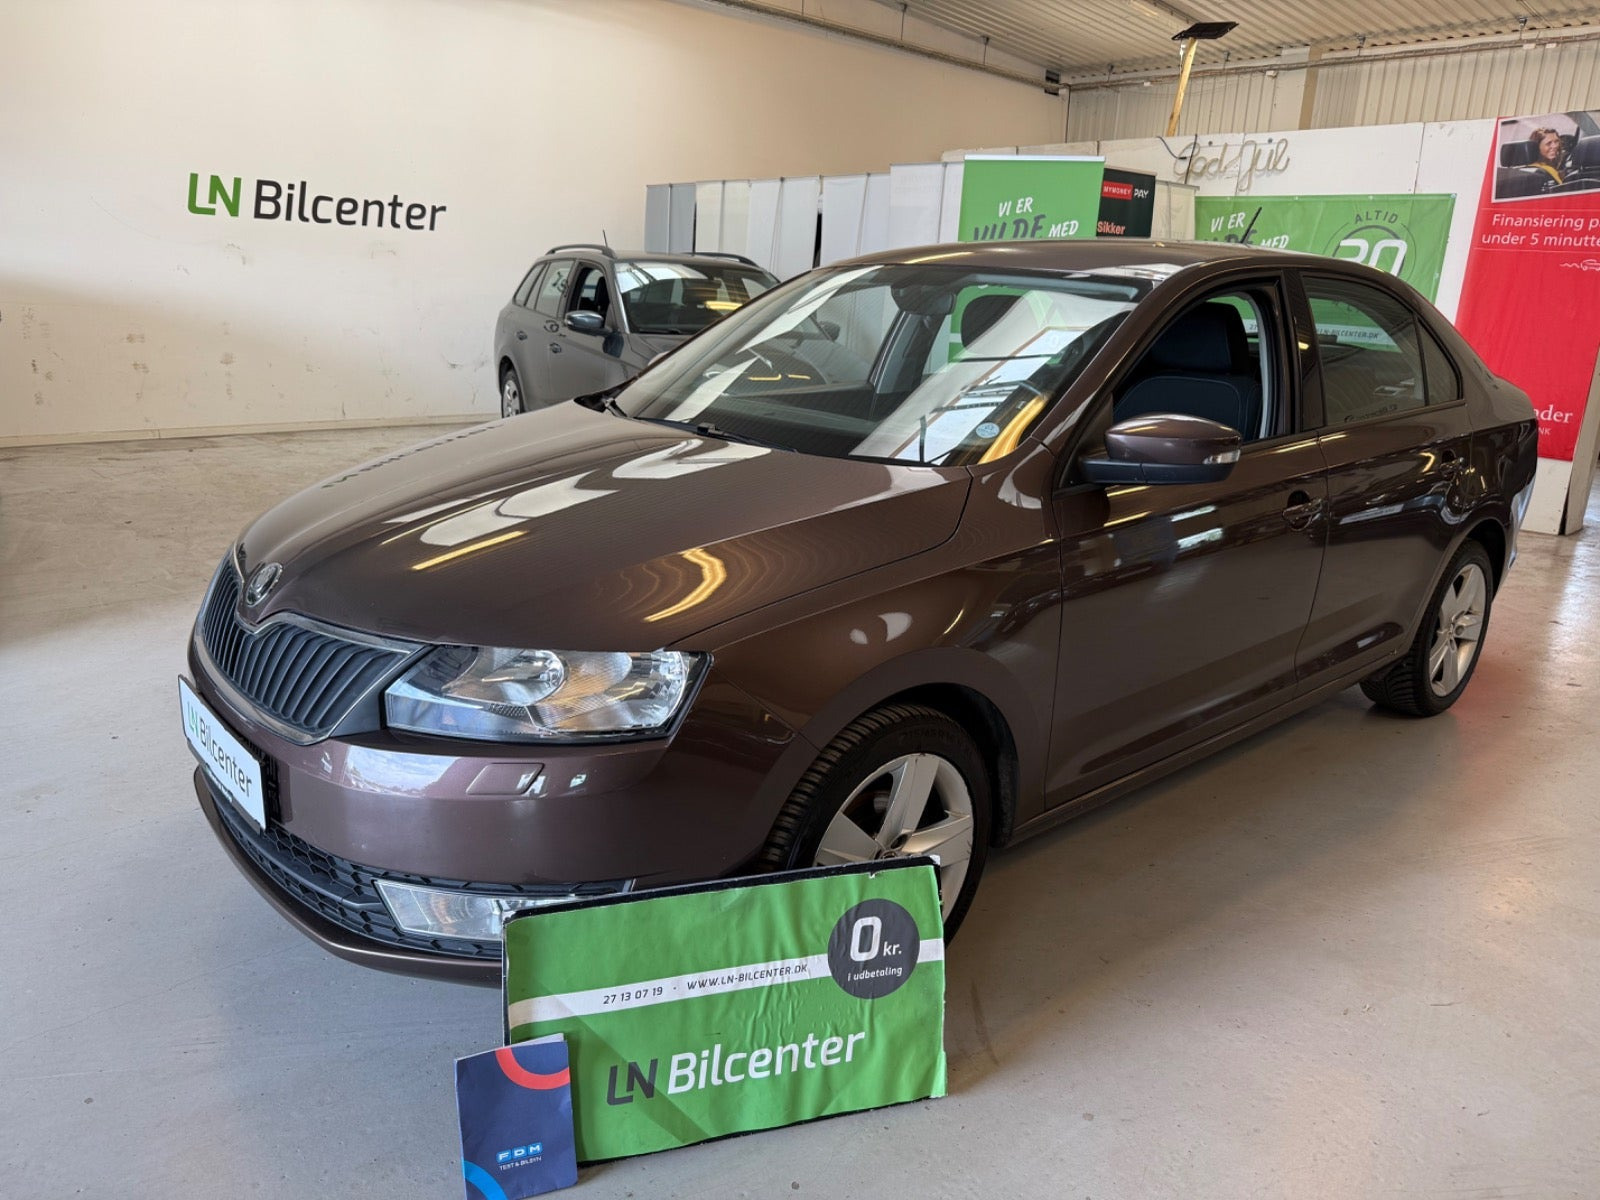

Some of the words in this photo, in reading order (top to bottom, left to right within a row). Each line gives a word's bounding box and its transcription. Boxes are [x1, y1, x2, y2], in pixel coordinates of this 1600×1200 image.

[1236, 138, 1290, 192] Jul
[187, 172, 242, 217] LN
[253, 179, 447, 231] Bilcenter
[1134, 188, 1149, 198] PAY
[998, 201, 1012, 217] VI
[1015, 197, 1034, 214] ER
[1210, 216, 1225, 233] VI
[1228, 212, 1246, 229] ER
[1355, 209, 1399, 225] ALTID
[1492, 213, 1584, 231] Finansiering
[1588, 217, 1600, 231] p
[1048, 220, 1080, 237] MED
[1097, 221, 1126, 235] Sikker
[1482, 232, 1526, 245] under
[1530, 233, 1540, 246] 5
[187, 701, 199, 738] LN
[199, 716, 252, 798] Bilcenter
[850, 916, 882, 961] 0
[883, 941, 902, 957] kr.
[853, 967, 903, 981] udbetaling
[603, 994, 617, 1005] 27
[620, 991, 632, 1002] 13
[634, 988, 649, 1000] 07
[652, 986, 663, 996] 19
[687, 964, 808, 990] WWW.LN-BILCENTER.DK
[606, 1058, 659, 1106] LN
[667, 1031, 866, 1095] Bilcenter
[498, 1144, 541, 1161] FDM
